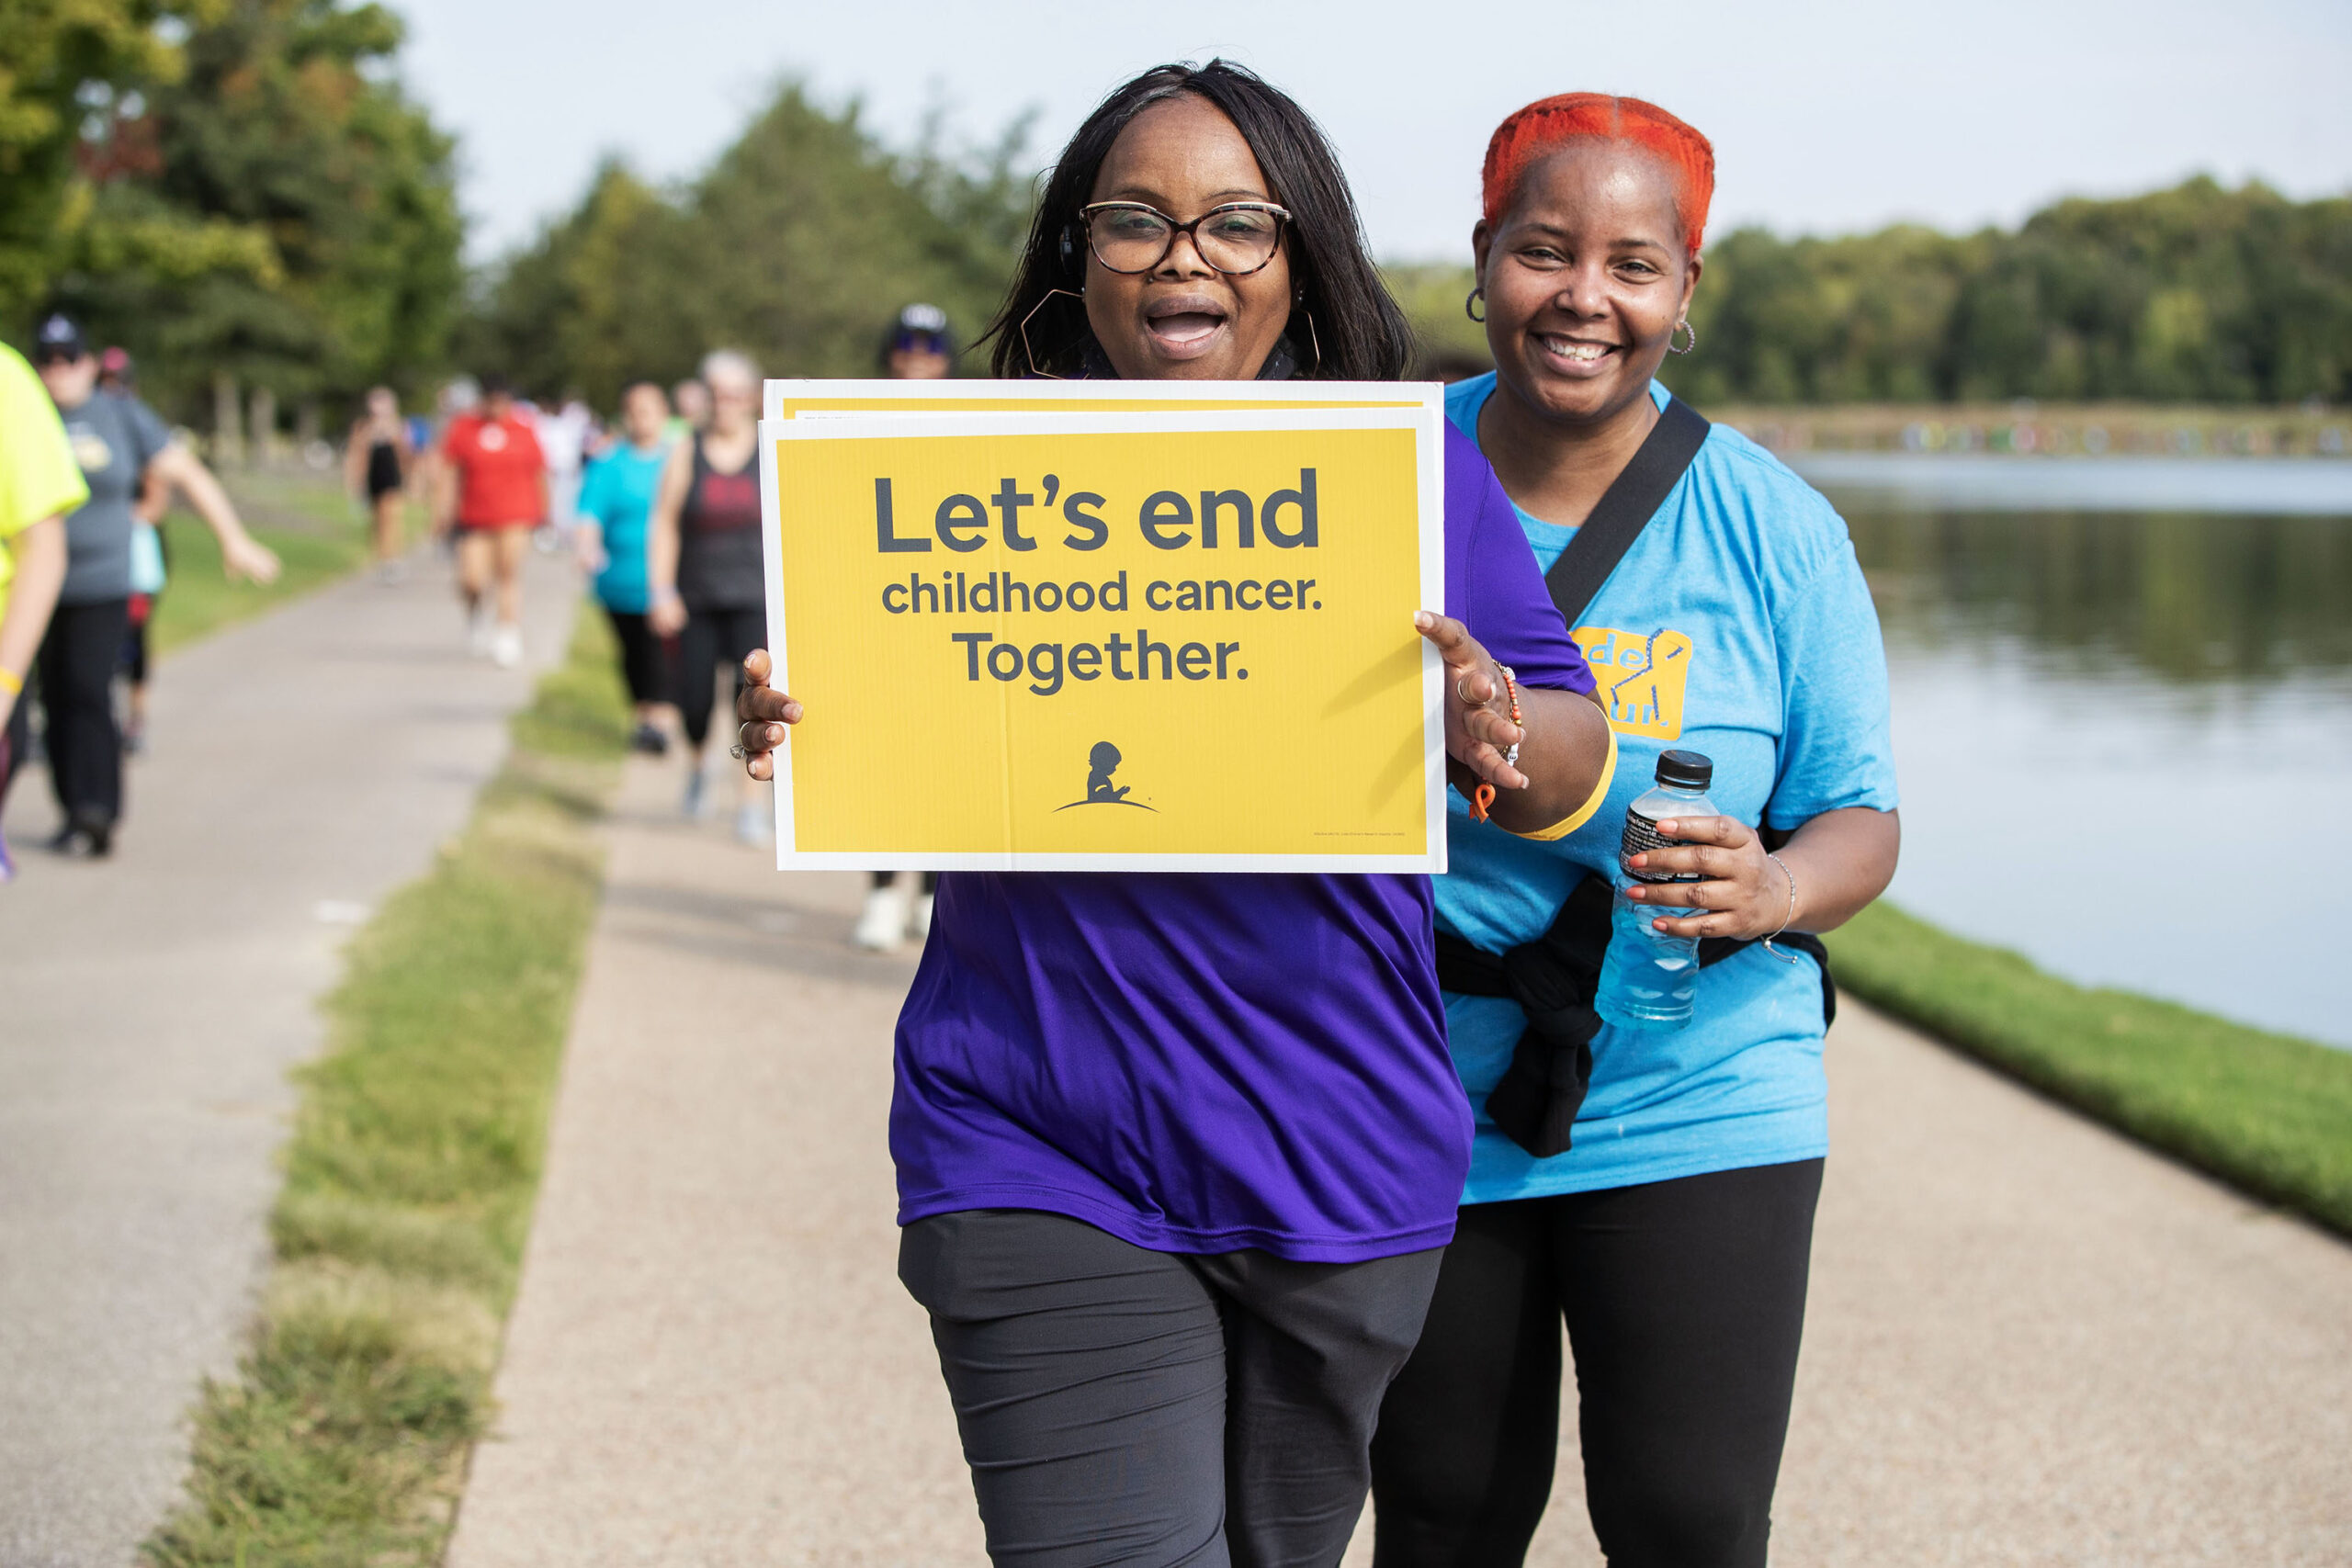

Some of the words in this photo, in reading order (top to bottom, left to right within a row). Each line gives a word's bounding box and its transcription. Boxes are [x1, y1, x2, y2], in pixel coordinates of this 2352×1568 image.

[875, 474, 1109, 553] Let’s
[1139, 468, 1318, 550] end
[882, 570, 1128, 614] childhood
[1145, 579, 1322, 612] cancer.
[951, 629, 1249, 696] Together.
